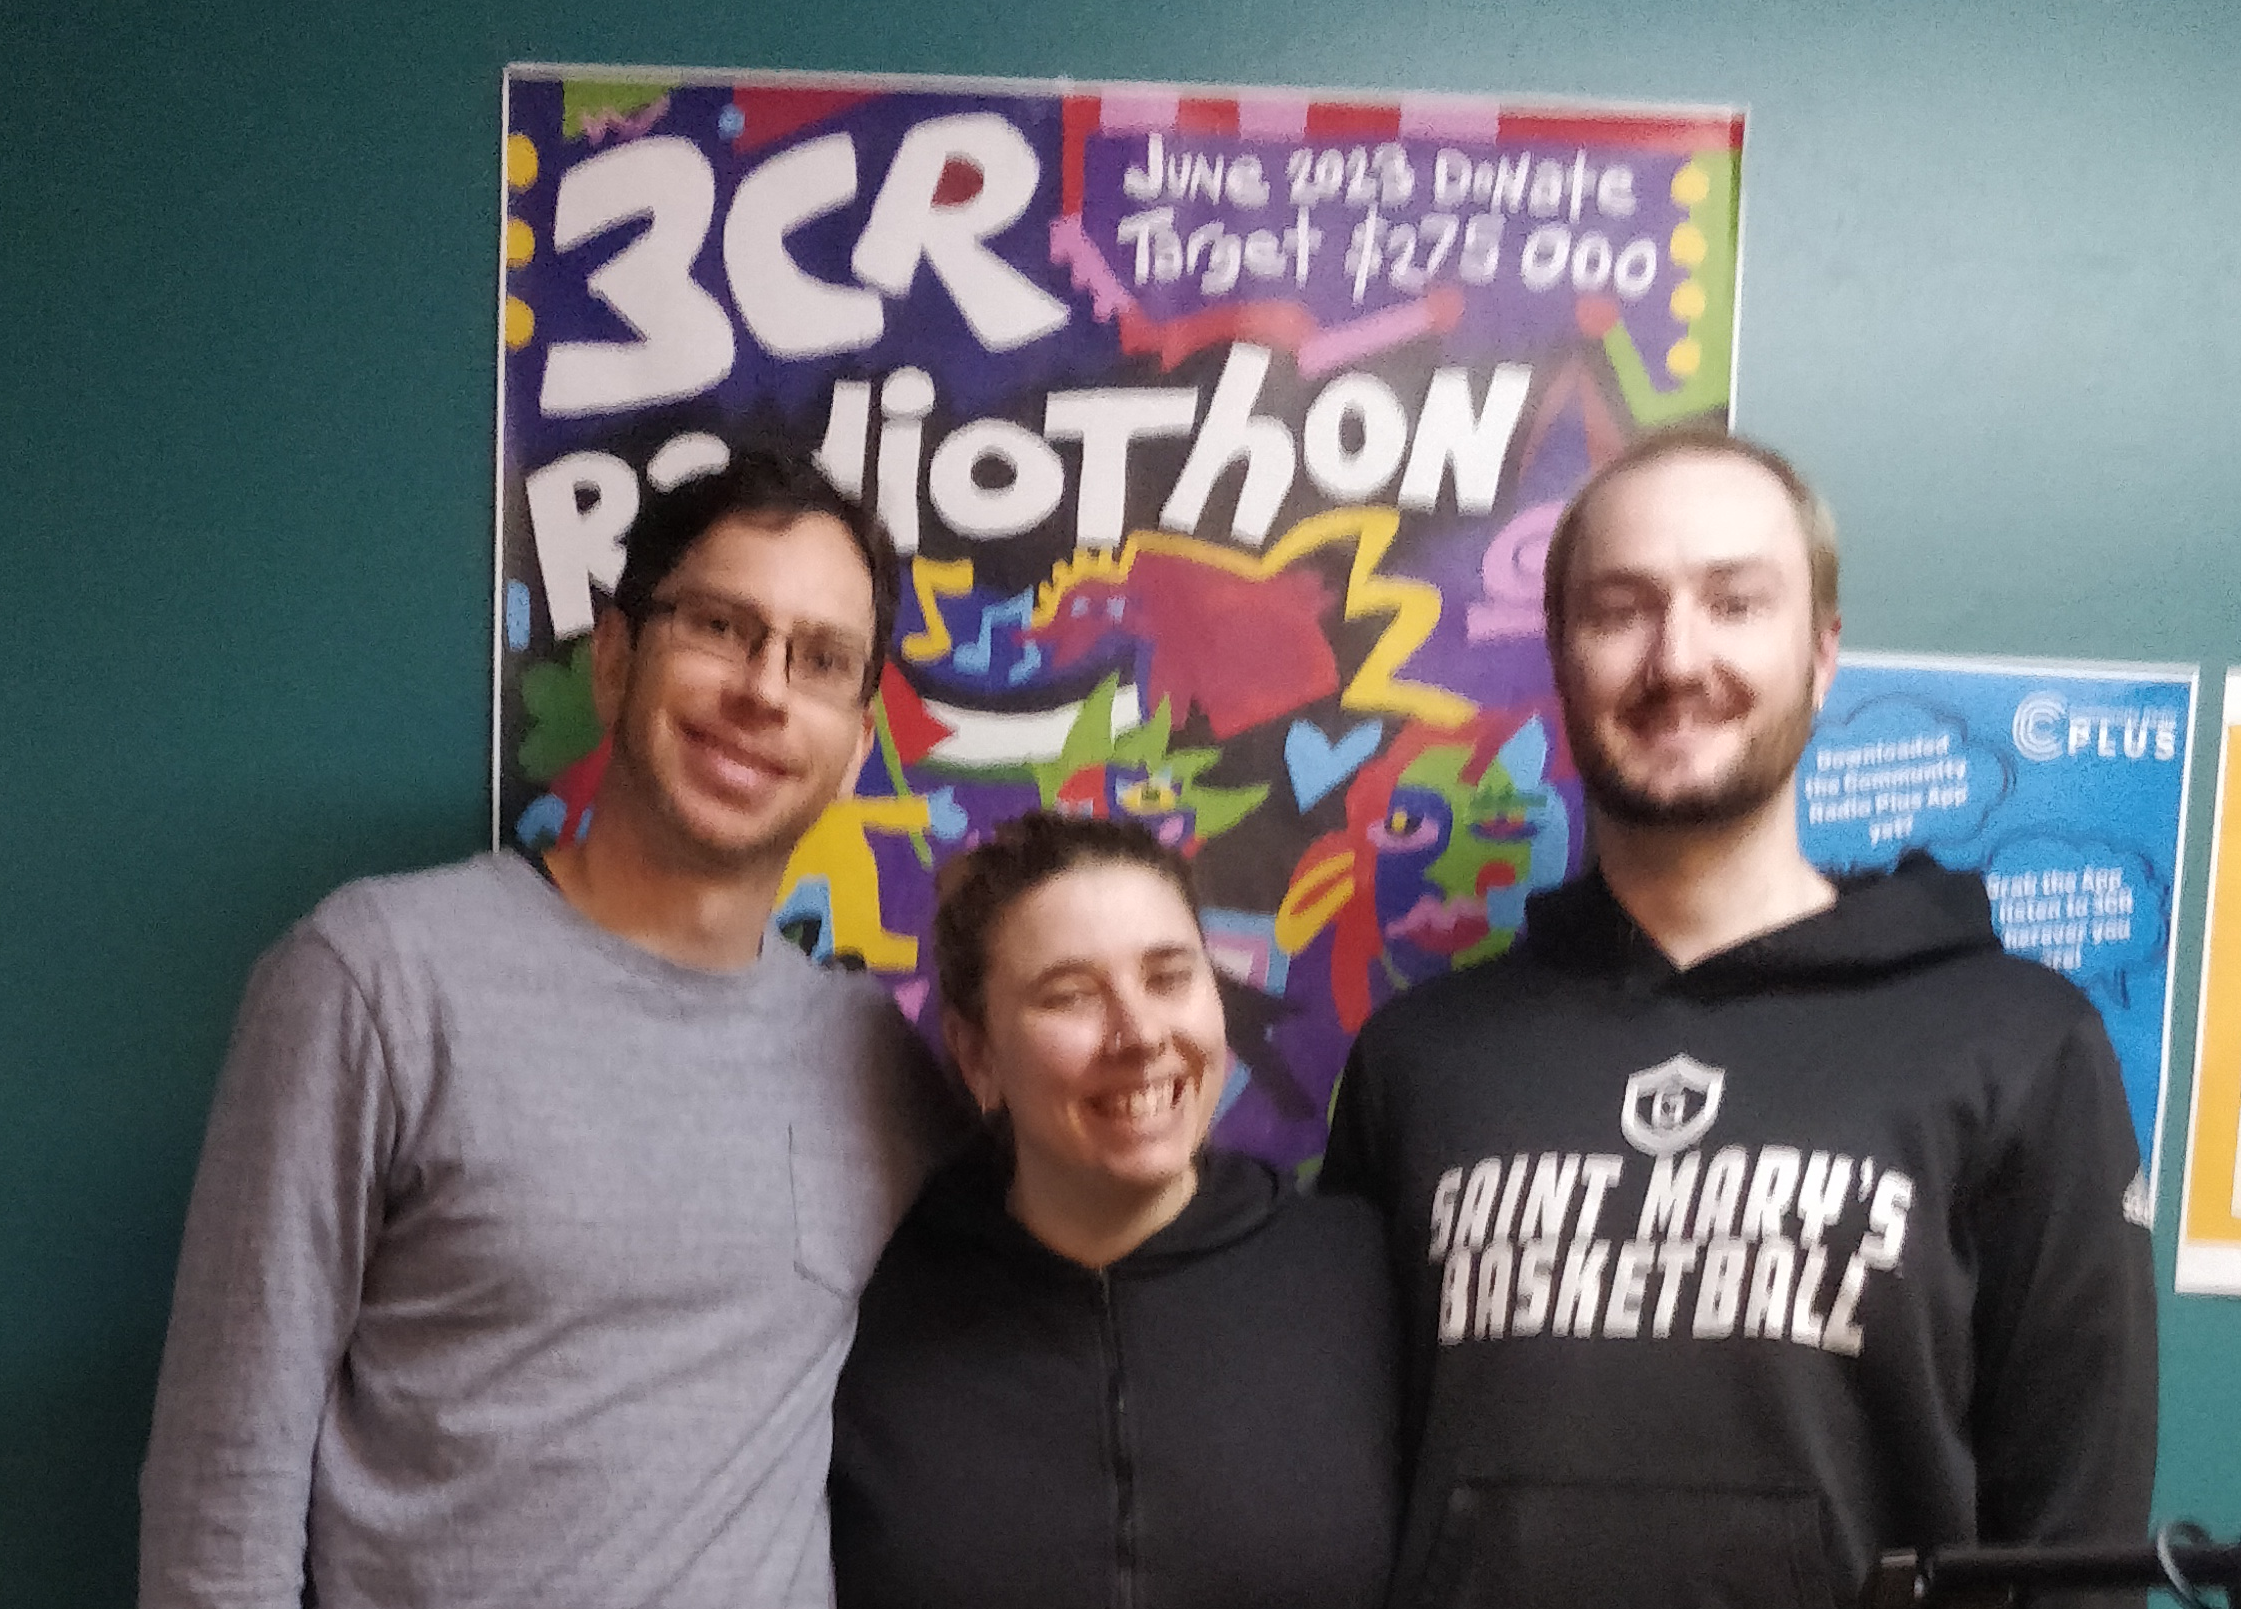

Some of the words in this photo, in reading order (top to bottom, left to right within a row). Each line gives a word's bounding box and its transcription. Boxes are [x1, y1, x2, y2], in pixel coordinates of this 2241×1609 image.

[539, 110, 1070, 417] 3CR
[1520, 222, 1657, 300] 000
[1428, 1150, 1624, 1264] SAINT
[1636, 1145, 1915, 1271] MARY'S
[1437, 1236, 1866, 1357] BASKETBALL
